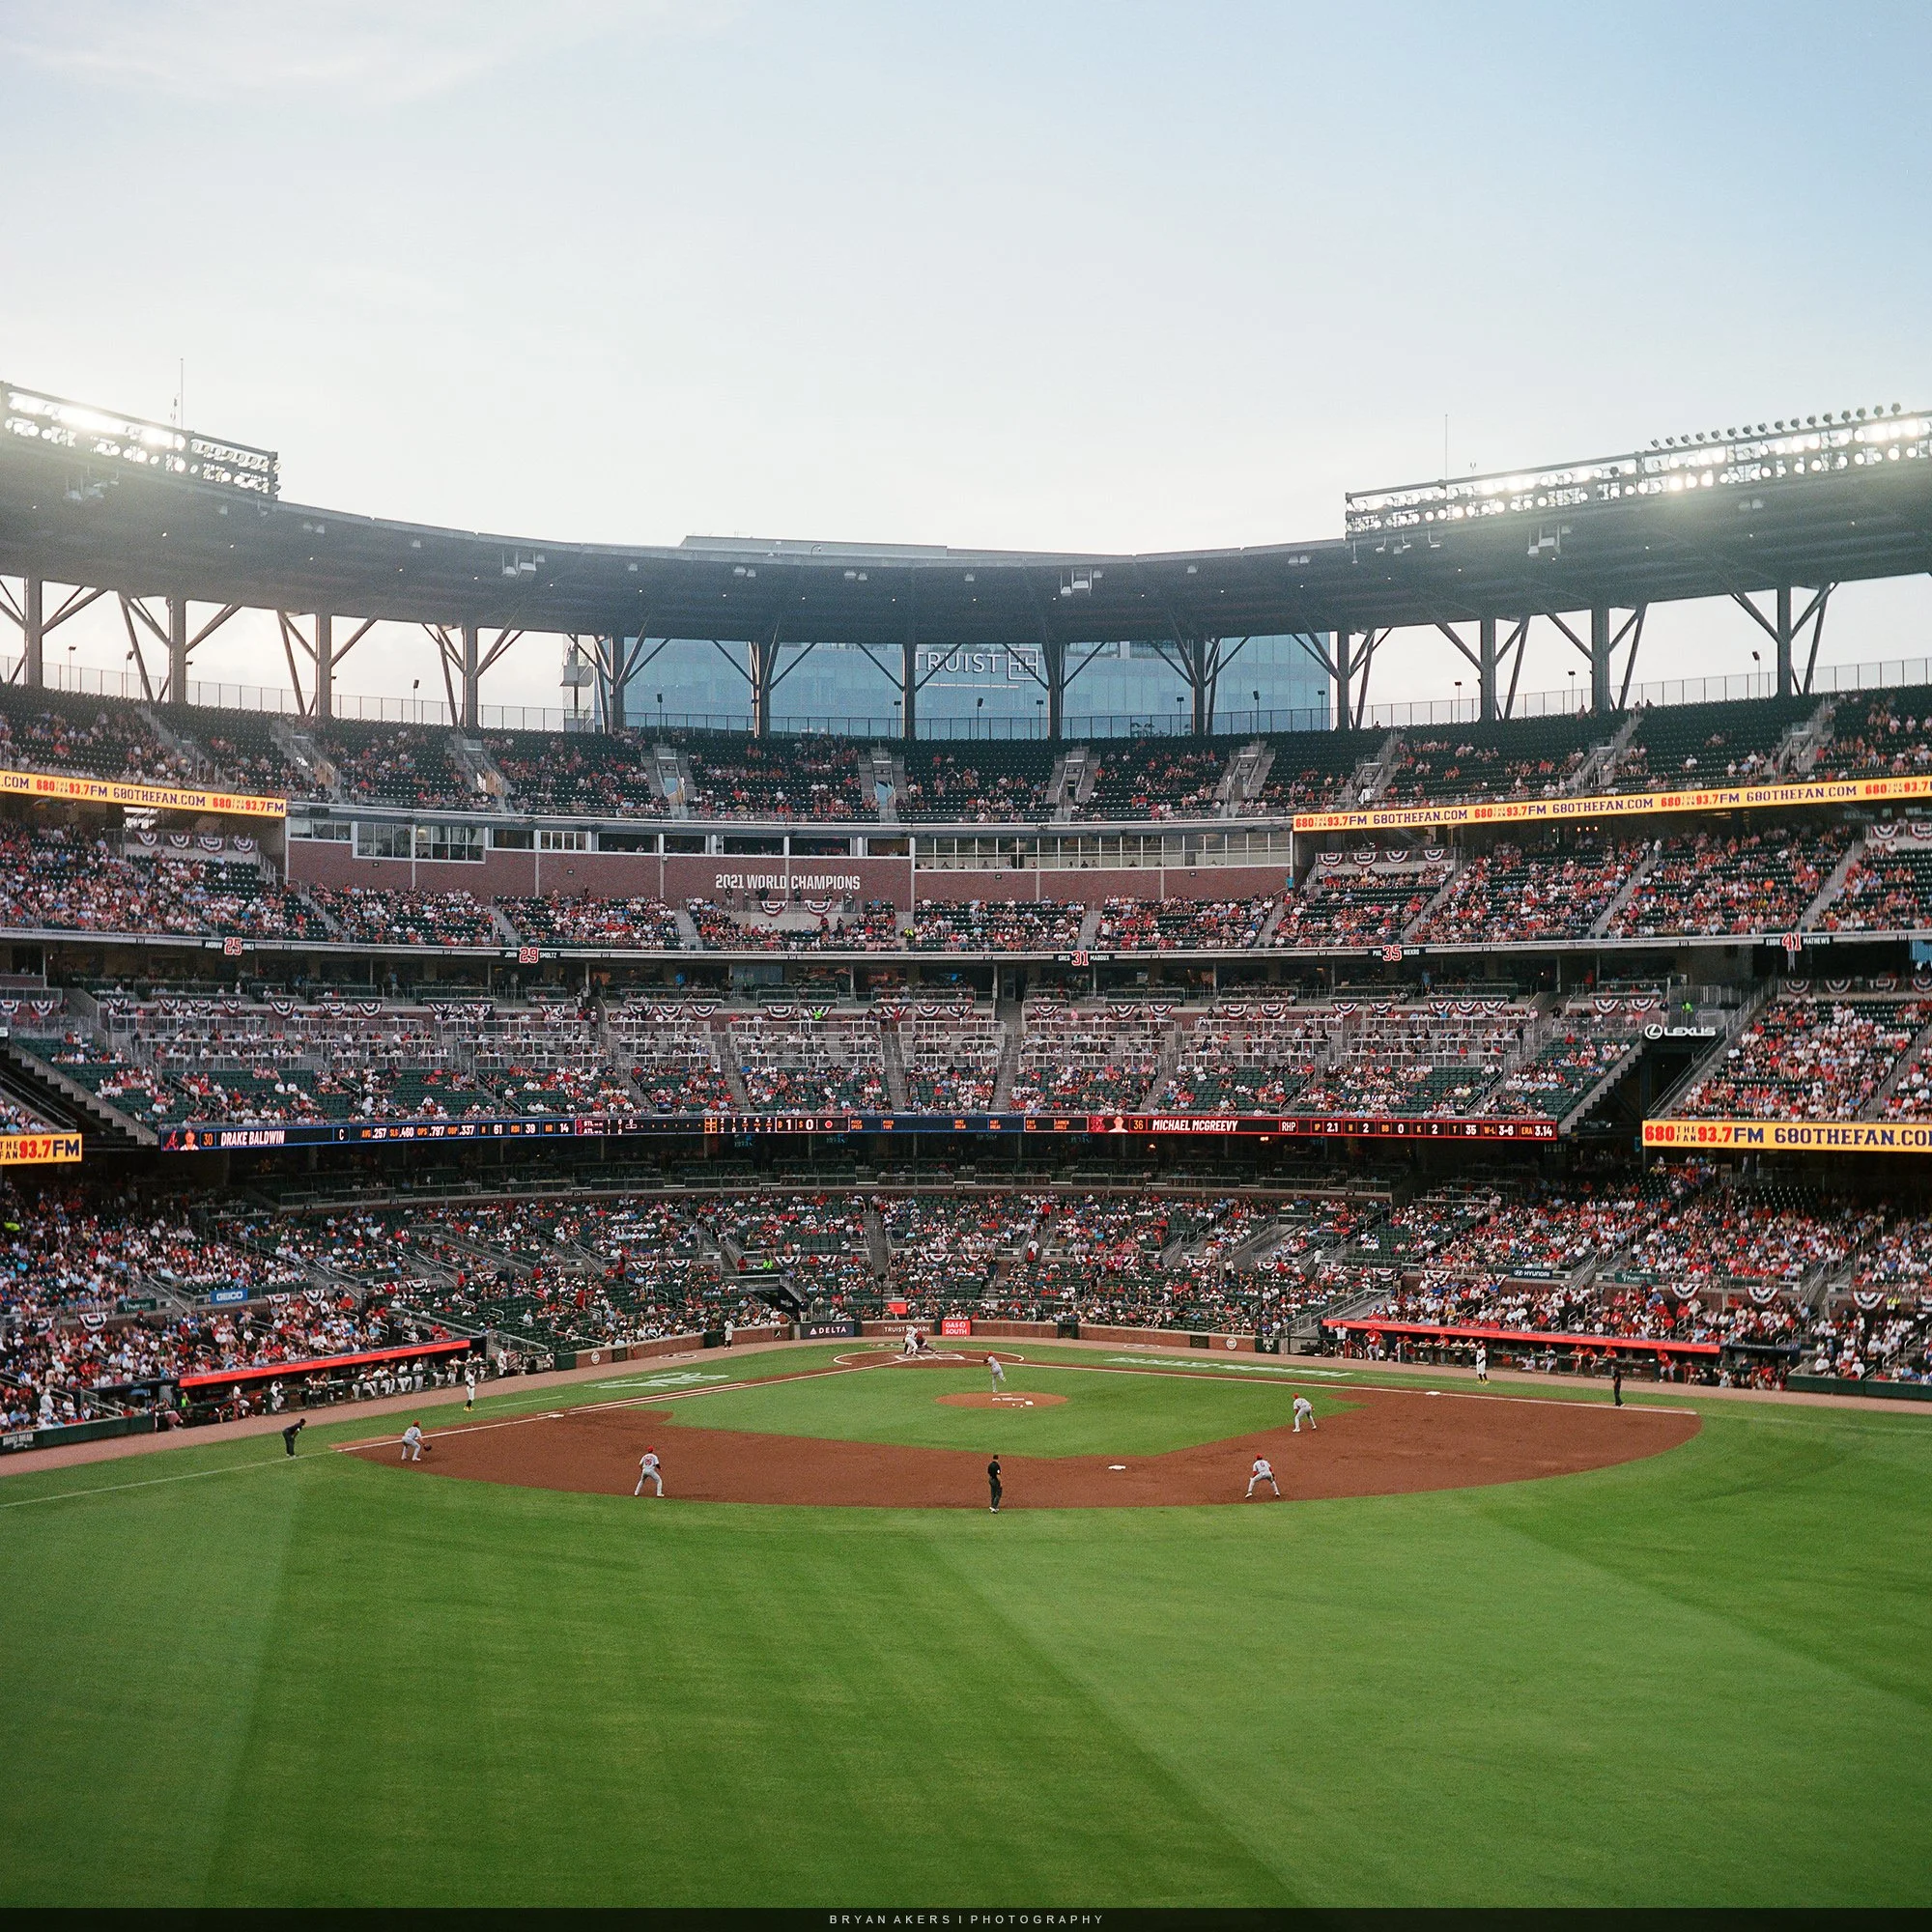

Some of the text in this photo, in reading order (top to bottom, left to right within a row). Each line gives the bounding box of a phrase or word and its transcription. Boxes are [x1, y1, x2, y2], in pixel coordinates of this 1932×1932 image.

[915, 651, 1002, 673] TRUIST
[36, 779, 55, 792] 680
[113, 787, 206, 807] 680THEFAN.COM
[213, 795, 232, 810] 680
[1295, 816, 1314, 828] 680
[1373, 809, 1467, 825] 680THEFAN.COM
[1474, 808, 1493, 819] 680
[1552, 798, 1653, 814] 680THEFAN.COM
[1661, 796, 1681, 808] 680
[1746, 784, 1858, 803] 680THEFAN.COM
[1865, 781, 1887, 795] 680
[1903, 779, 1932, 793] 93.7
[715, 874, 861, 890] 2021 WORLD CHAMPIONS
[224, 936, 242, 955] 25
[1781, 932, 1802, 952] 41
[519, 946, 539, 963] 29
[1071, 950, 1089, 966] 31
[1382, 944, 1402, 961] 35
[1663, 1026, 1716, 1037] LEXUS
[429, 1125, 444, 1137] .797
[459, 1124, 474, 1136] .337
[493, 1124, 503, 1135] 61
[525, 1122, 535, 1134] 39
[559, 1122, 569, 1133] 14
[786, 1119, 792, 1130] 1
[806, 1119, 814, 1130] 0
[1133, 1119, 1296, 1132] 36 MICHAEL MCGREEVY RHP
[1326, 1122, 1339, 1133] 2.1
[1363, 1122, 1369, 1133] 2
[1398, 1123, 1405, 1134] 0
[1432, 1123, 1437, 1134] 2
[1465, 1123, 1476, 1135] 35
[1520, 1126, 1532, 1135] ERA
[1534, 1124, 1552, 1137] 3.14
[203, 1133, 213, 1147] 30
[220, 1130, 247, 1147] DRAKE
[248, 1129, 285, 1146] BALDWIN
[1644, 1124, 1675, 1142] 680
[1676, 1134, 1696, 1143] FAN
[215, 1291, 242, 1301] GEICO
[819, 1326, 846, 1335] DELTA
